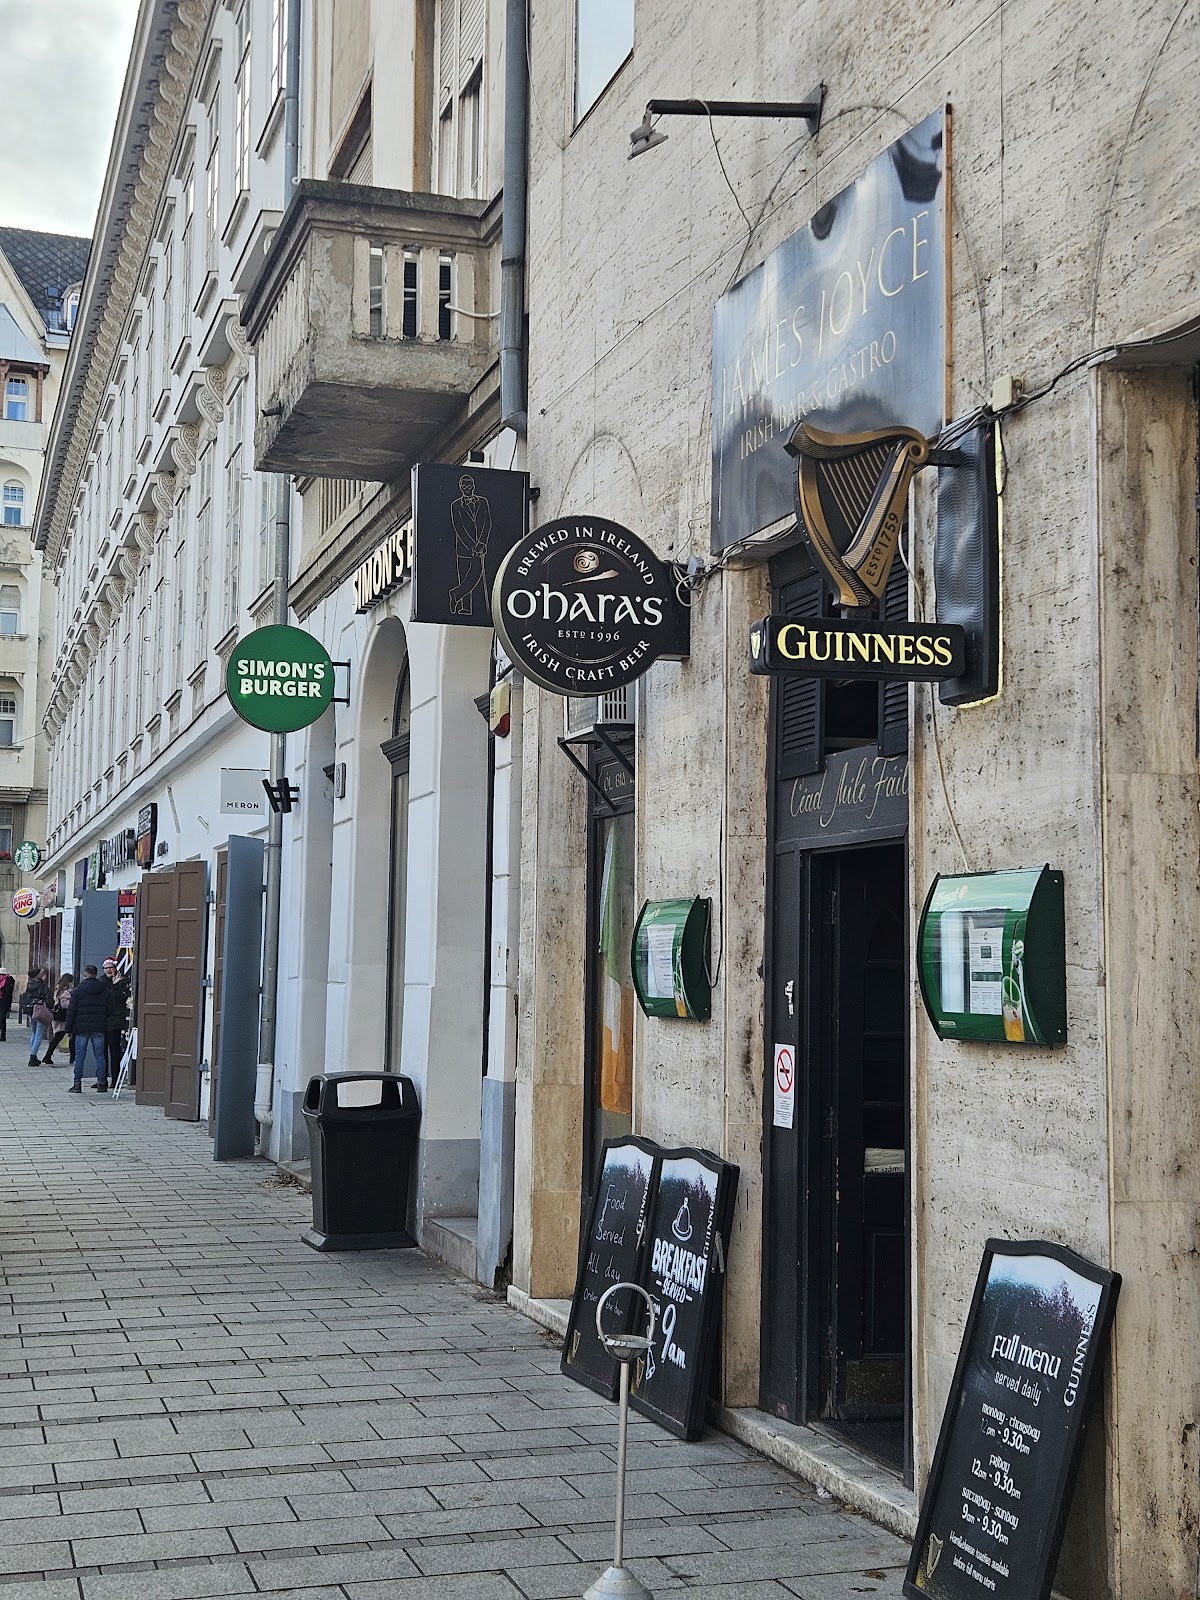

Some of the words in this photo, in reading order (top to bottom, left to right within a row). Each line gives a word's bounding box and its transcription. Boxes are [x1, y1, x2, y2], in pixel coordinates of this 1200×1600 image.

[721, 305, 805, 435] JAMES
[818, 210, 929, 359] JOYCE
[740, 412, 774, 460] IRISH
[779, 391, 807, 432] BAR
[811, 381, 823, 410] &
[826, 330, 896, 399] GASTRO
[878, 512, 899, 549] 1759
[352, 529, 404, 614] SIMON'S
[517, 528, 569, 576] BREWED
[575, 526, 593, 538] IN
[600, 530, 655, 585] IRELAND
[590, 630, 620, 642] 1996
[776, 623, 953, 666] GUINNESS
[237, 659, 325, 679] SIMON'S
[521, 633, 561, 673] IRISH
[565, 666, 614, 681] CRAFT
[620, 639, 651, 671] BEER
[240, 678, 322, 698] BURGER
[226, 802, 259, 810] MERON
[14, 893, 32, 903] BURGER
[14, 898, 33, 911] KING
[602, 1184, 629, 1220] Food
[596, 1218, 626, 1247] Served
[604, 1255, 622, 1296] day
[651, 1237, 708, 1294] BREAKFAST
[661, 1303, 676, 1363] 9
[1020, 1343, 1062, 1379] menu
[1063, 1303, 1096, 1407] GUINNESS
[994, 1371, 1022, 1393] served
[1021, 1378, 1042, 1407] daily
[1002, 1427, 1031, 1455] 9.30pm
[971, 1457, 987, 1480] 12pm
[993, 1470, 1021, 1499] 9.30pm
[961, 1503, 975, 1524] 9am
[981, 1515, 1009, 1545] 9.30pm
